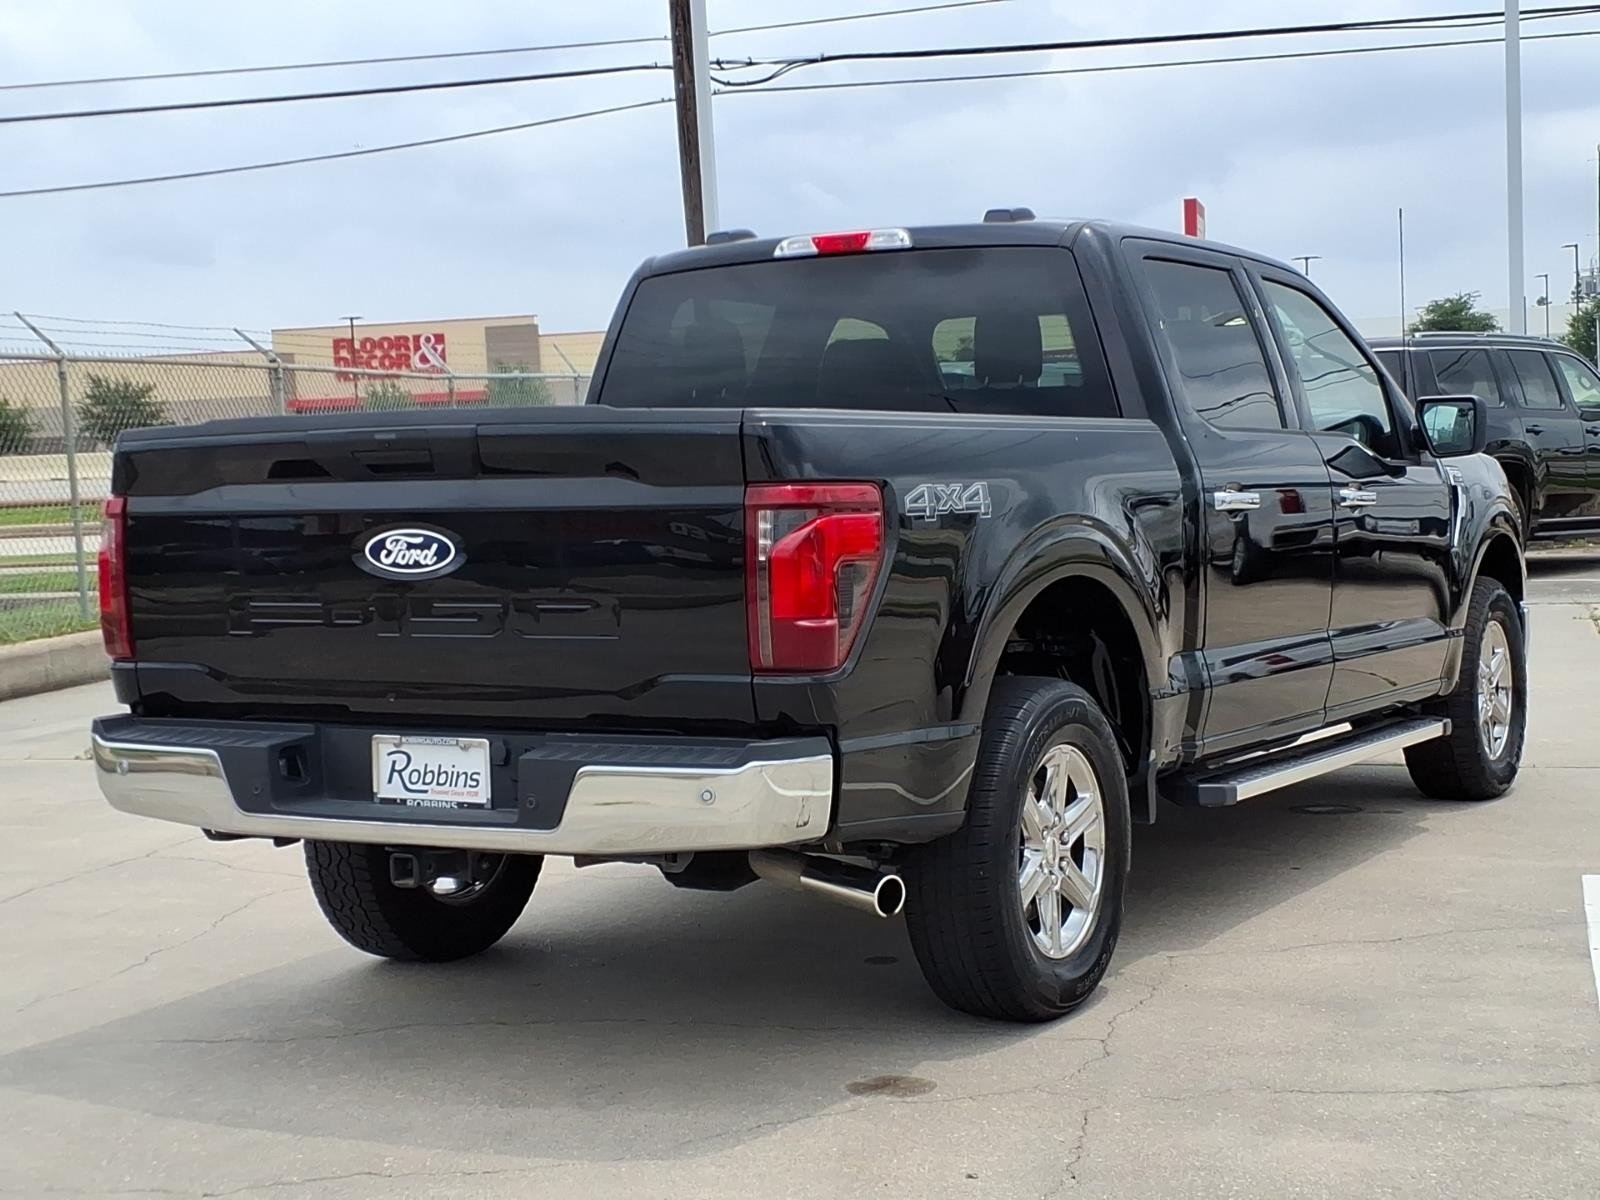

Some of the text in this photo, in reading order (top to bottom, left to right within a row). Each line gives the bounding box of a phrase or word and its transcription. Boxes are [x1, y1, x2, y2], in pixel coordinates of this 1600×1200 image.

[333, 333, 448, 373] FLOOR &
[334, 354, 412, 371] DECOR
[380, 535, 438, 566] Ford
[386, 750, 481, 794] Robbins
